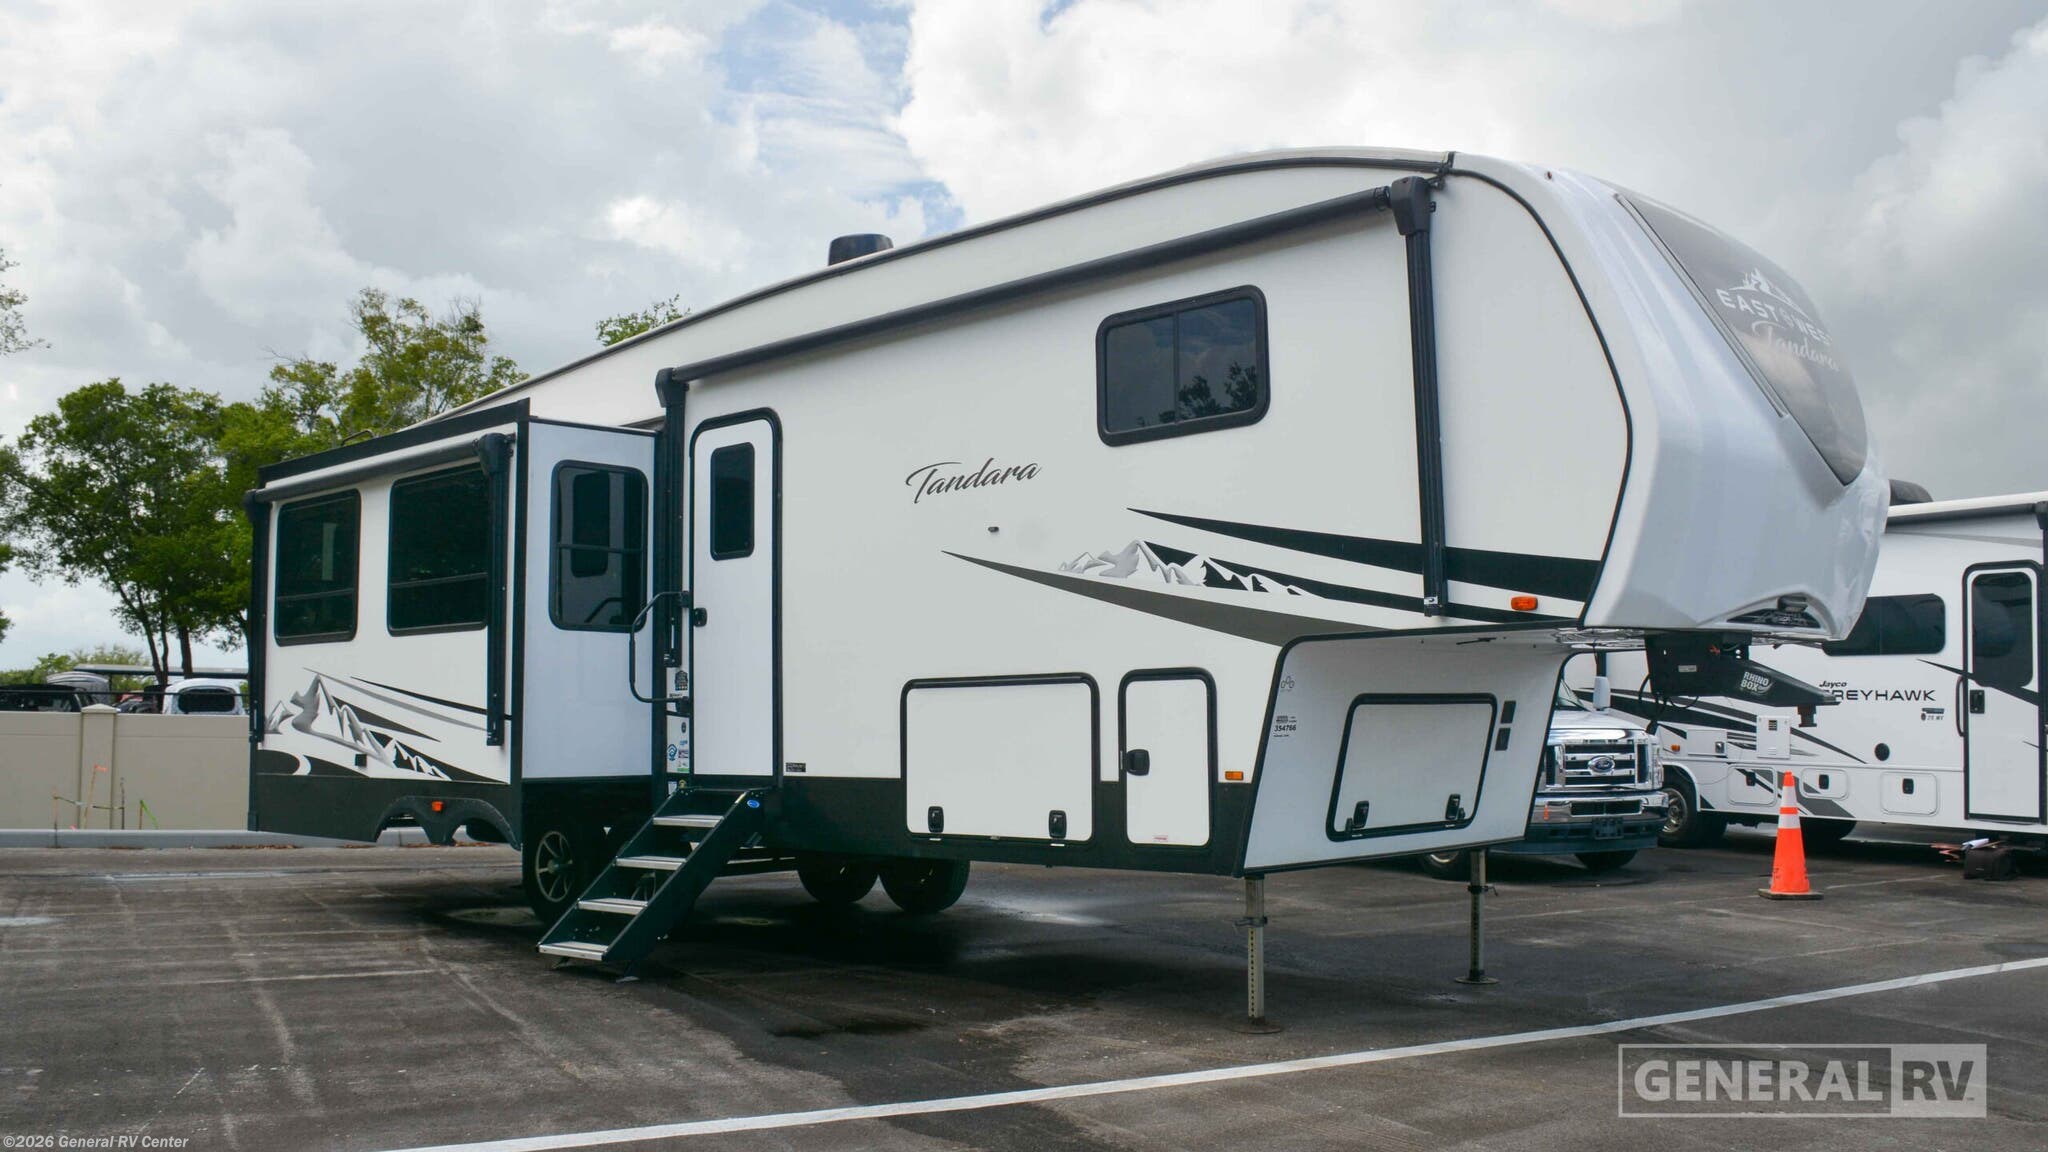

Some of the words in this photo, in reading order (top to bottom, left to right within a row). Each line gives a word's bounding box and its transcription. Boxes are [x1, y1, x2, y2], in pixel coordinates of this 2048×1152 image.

[1715, 288, 1779, 322] EAST
[905, 457, 1042, 504] Tandara
[1740, 679, 1760, 692] BOX
[1743, 671, 1770, 687] RHINO
[1819, 680, 1848, 689] Jayco
[1823, 689, 1936, 701] REYHAWK
